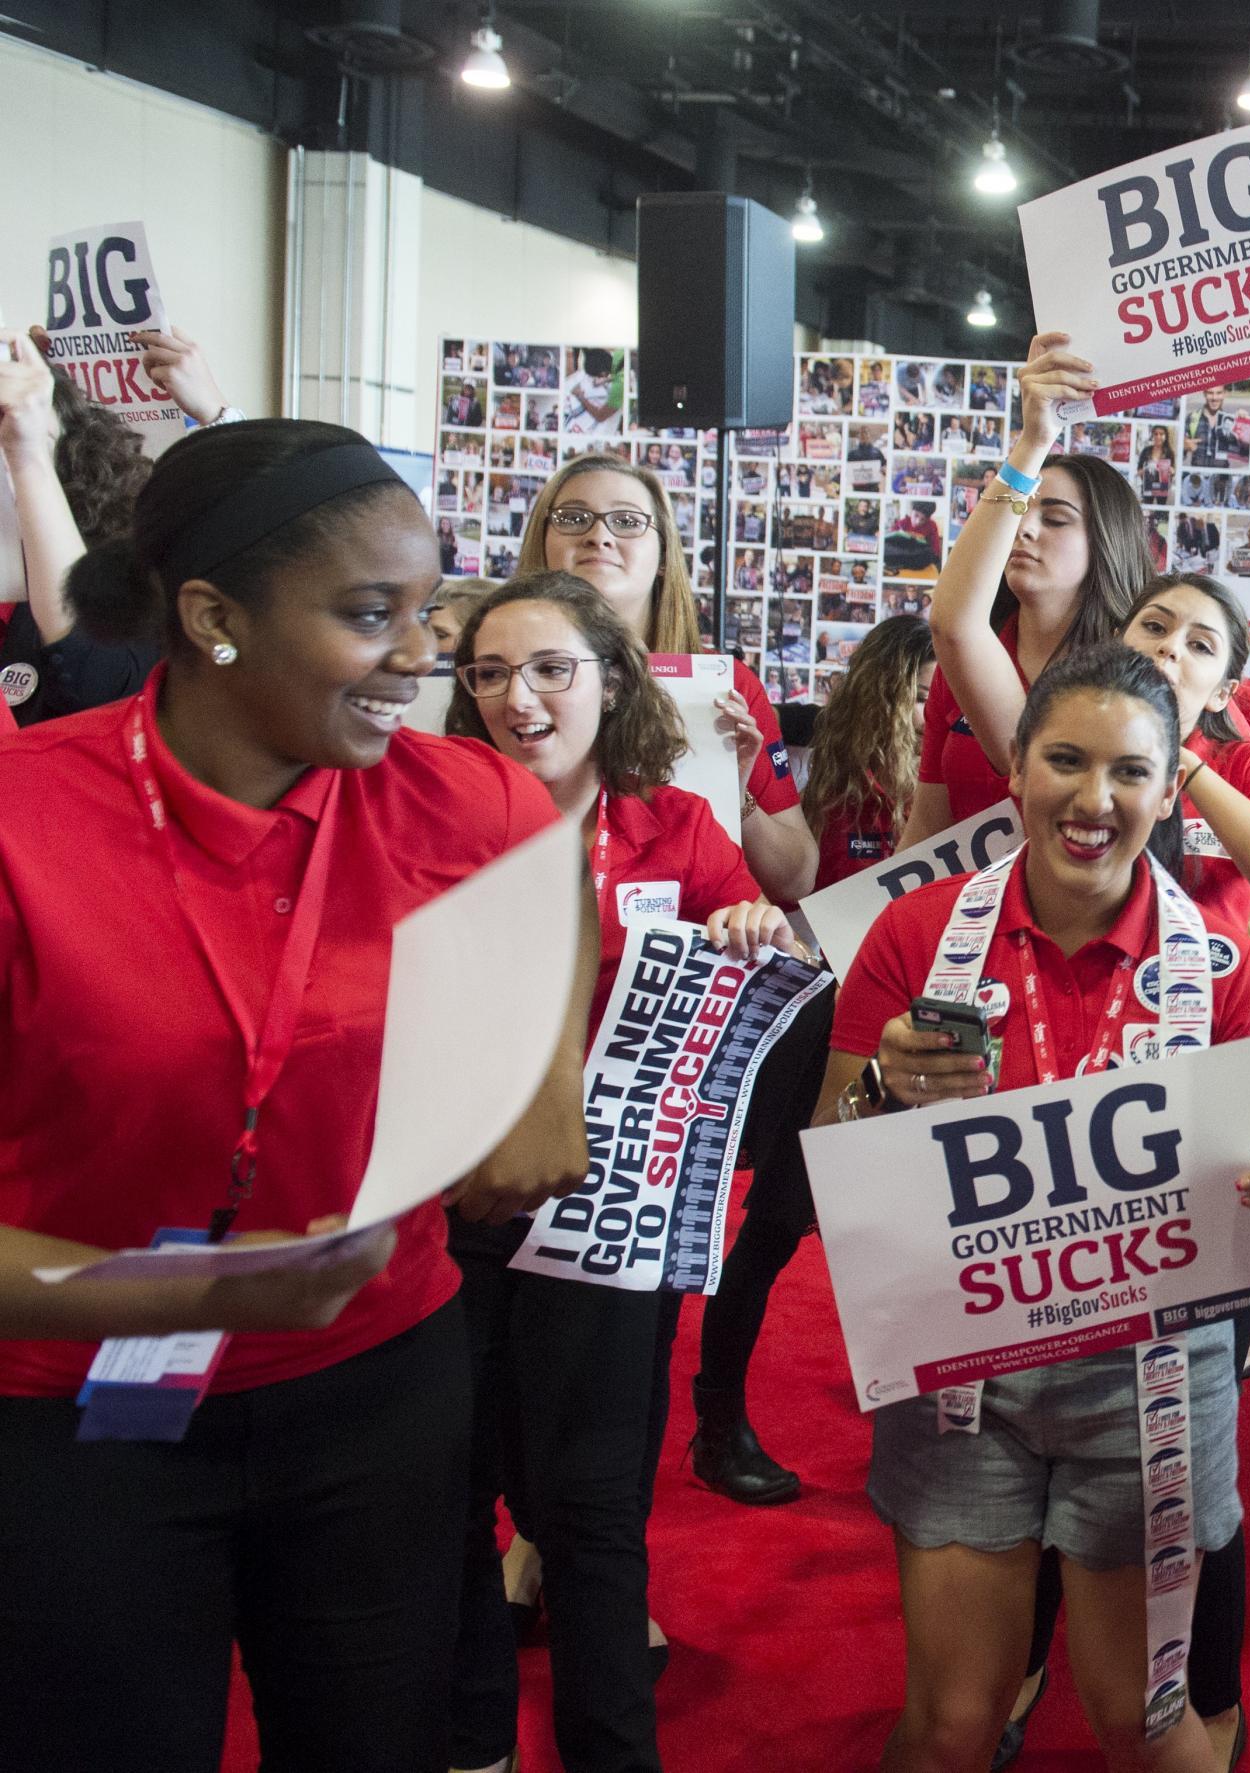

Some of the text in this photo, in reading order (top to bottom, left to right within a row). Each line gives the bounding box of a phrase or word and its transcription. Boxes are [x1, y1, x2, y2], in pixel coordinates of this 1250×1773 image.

[47, 236, 152, 331] BIG
[46, 329, 161, 358] GOVERNMEN
[52, 358, 177, 406] UCK
[1107, 381, 1151, 400] IDENTIFY
[1155, 368, 1200, 389] EMPOWER
[1148, 374, 1216, 398] WWW.TPUSA.COM
[3, 670, 31, 686] BIG
[535, 927, 686, 1263] I DON'T NEED
[581, 928, 723, 1275] GOVERNMENT
[707, 976, 828, 1287] WWW.BIGGOVERNMENTSUCKS.NET WWW.TURNINGPOINTUSA.NET
[931, 1082, 1182, 1227] BIG
[626, 1204, 667, 1269] TO
[951, 1188, 1190, 1260] GOVERNMENT
[959, 1218, 1199, 1315] SUCKS
[1027, 1284, 1148, 1329] #BigGovSucks
[1163, 1305, 1189, 1324] BIG
[936, 1321, 1131, 1375] IDENTIFY EMPOWER ORGANIZE
[992, 1346, 1080, 1371] WWW.TPUSA.COM
